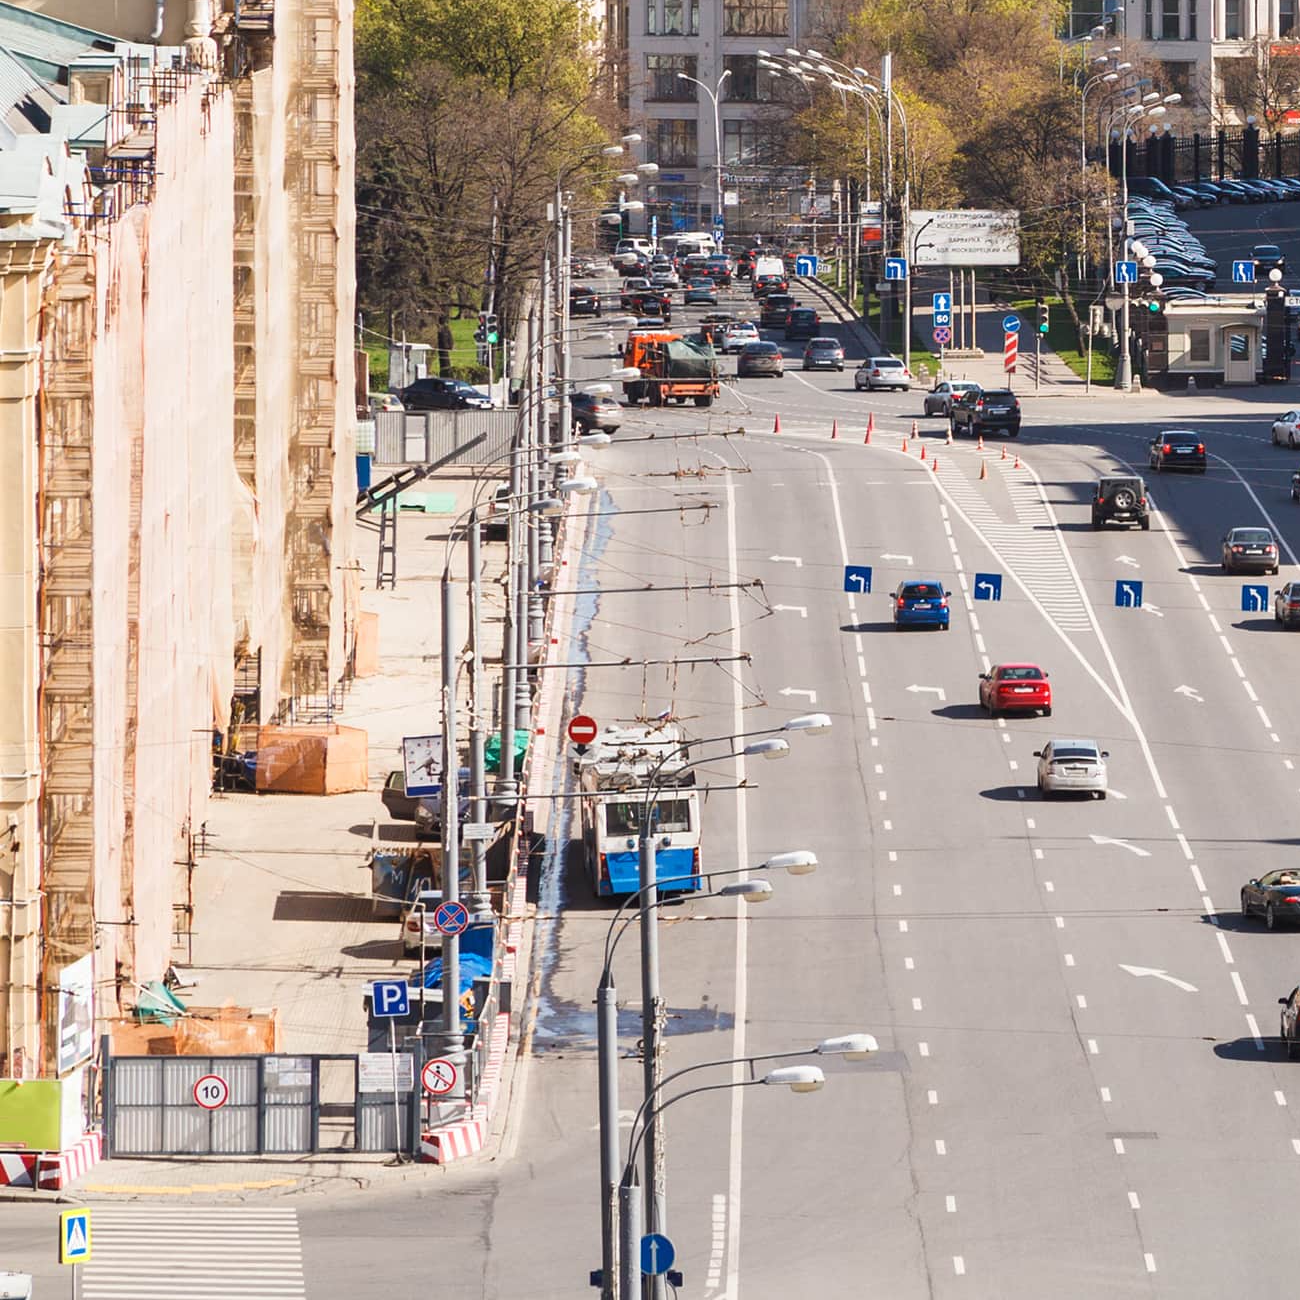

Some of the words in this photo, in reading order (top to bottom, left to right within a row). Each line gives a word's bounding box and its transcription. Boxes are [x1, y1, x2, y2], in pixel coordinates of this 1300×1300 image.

[936, 314, 949, 323] 50
[381, 984, 402, 1012] P
[202, 1084, 220, 1099] 10
